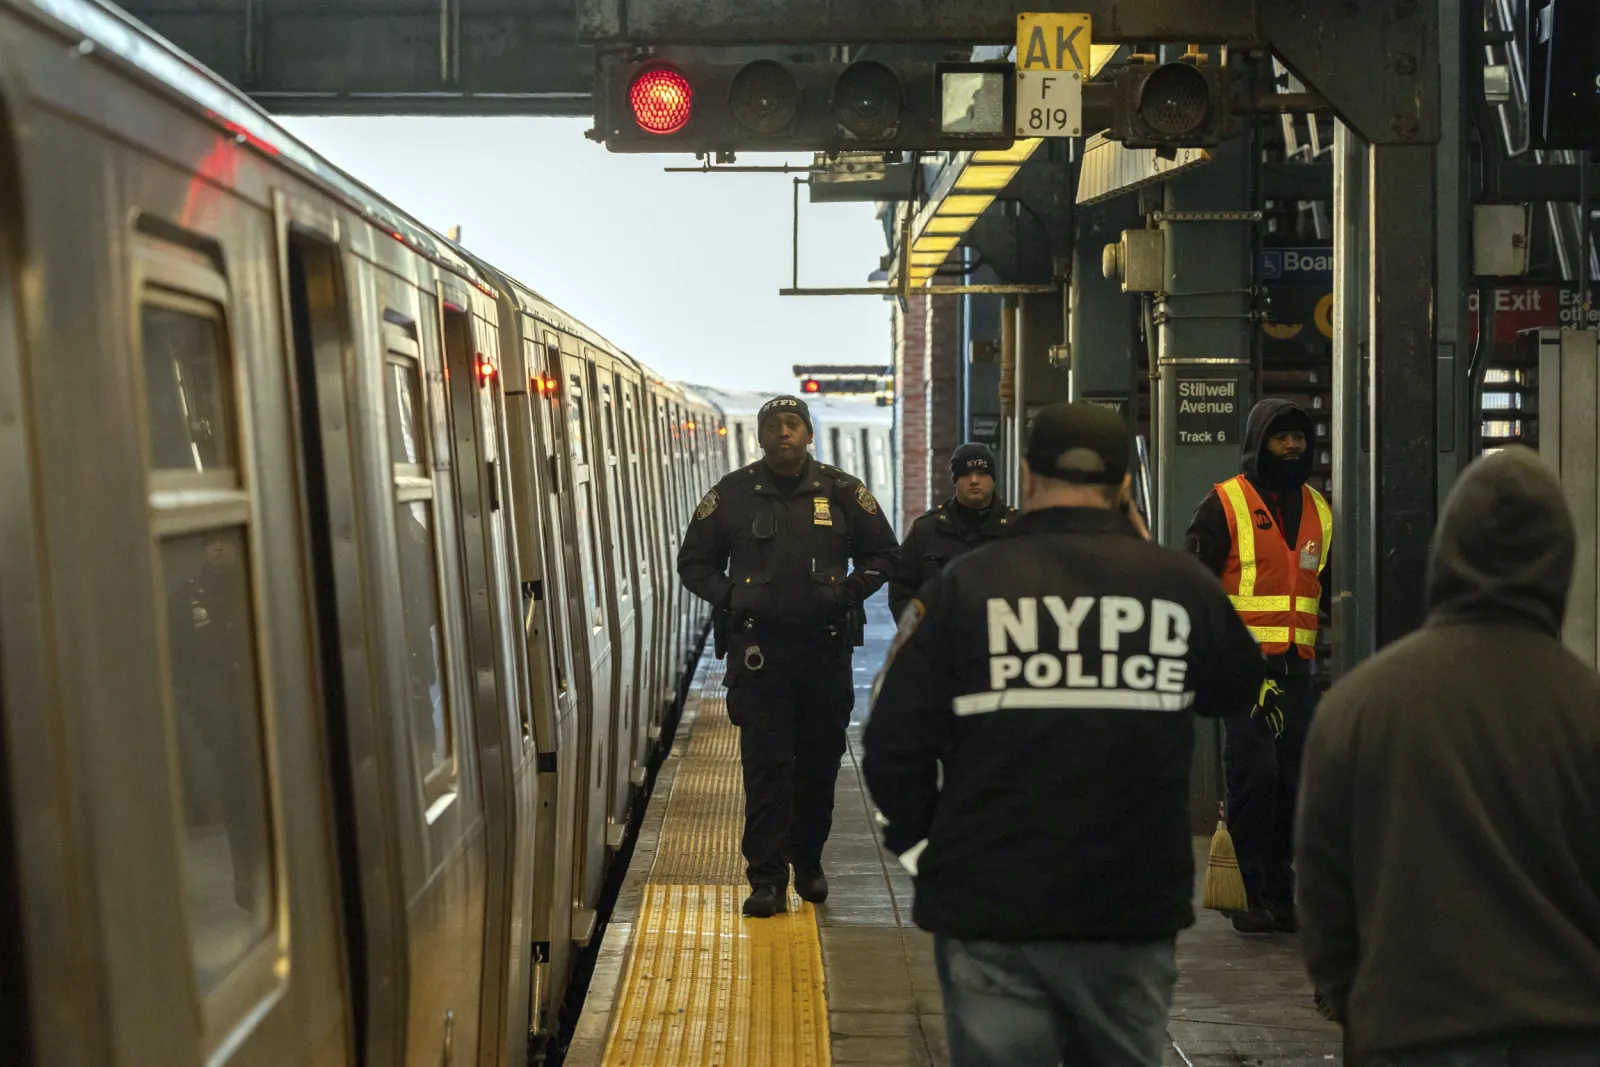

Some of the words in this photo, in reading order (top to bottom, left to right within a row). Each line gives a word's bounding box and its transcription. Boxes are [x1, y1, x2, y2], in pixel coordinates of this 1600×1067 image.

[1024, 25, 1084, 70] AK
[1042, 77, 1056, 99] F
[1029, 107, 1067, 130] 819
[1495, 289, 1541, 311] Exit
[1560, 289, 1592, 305] Ext
[1179, 382, 1235, 397] Stillwell
[763, 399, 797, 412] NYPD
[1179, 399, 1234, 413] Avenue
[1179, 431, 1213, 442] Track
[1217, 430, 1226, 442] 6
[987, 595, 1191, 657] NYPD
[989, 652, 1188, 692] POLICE
